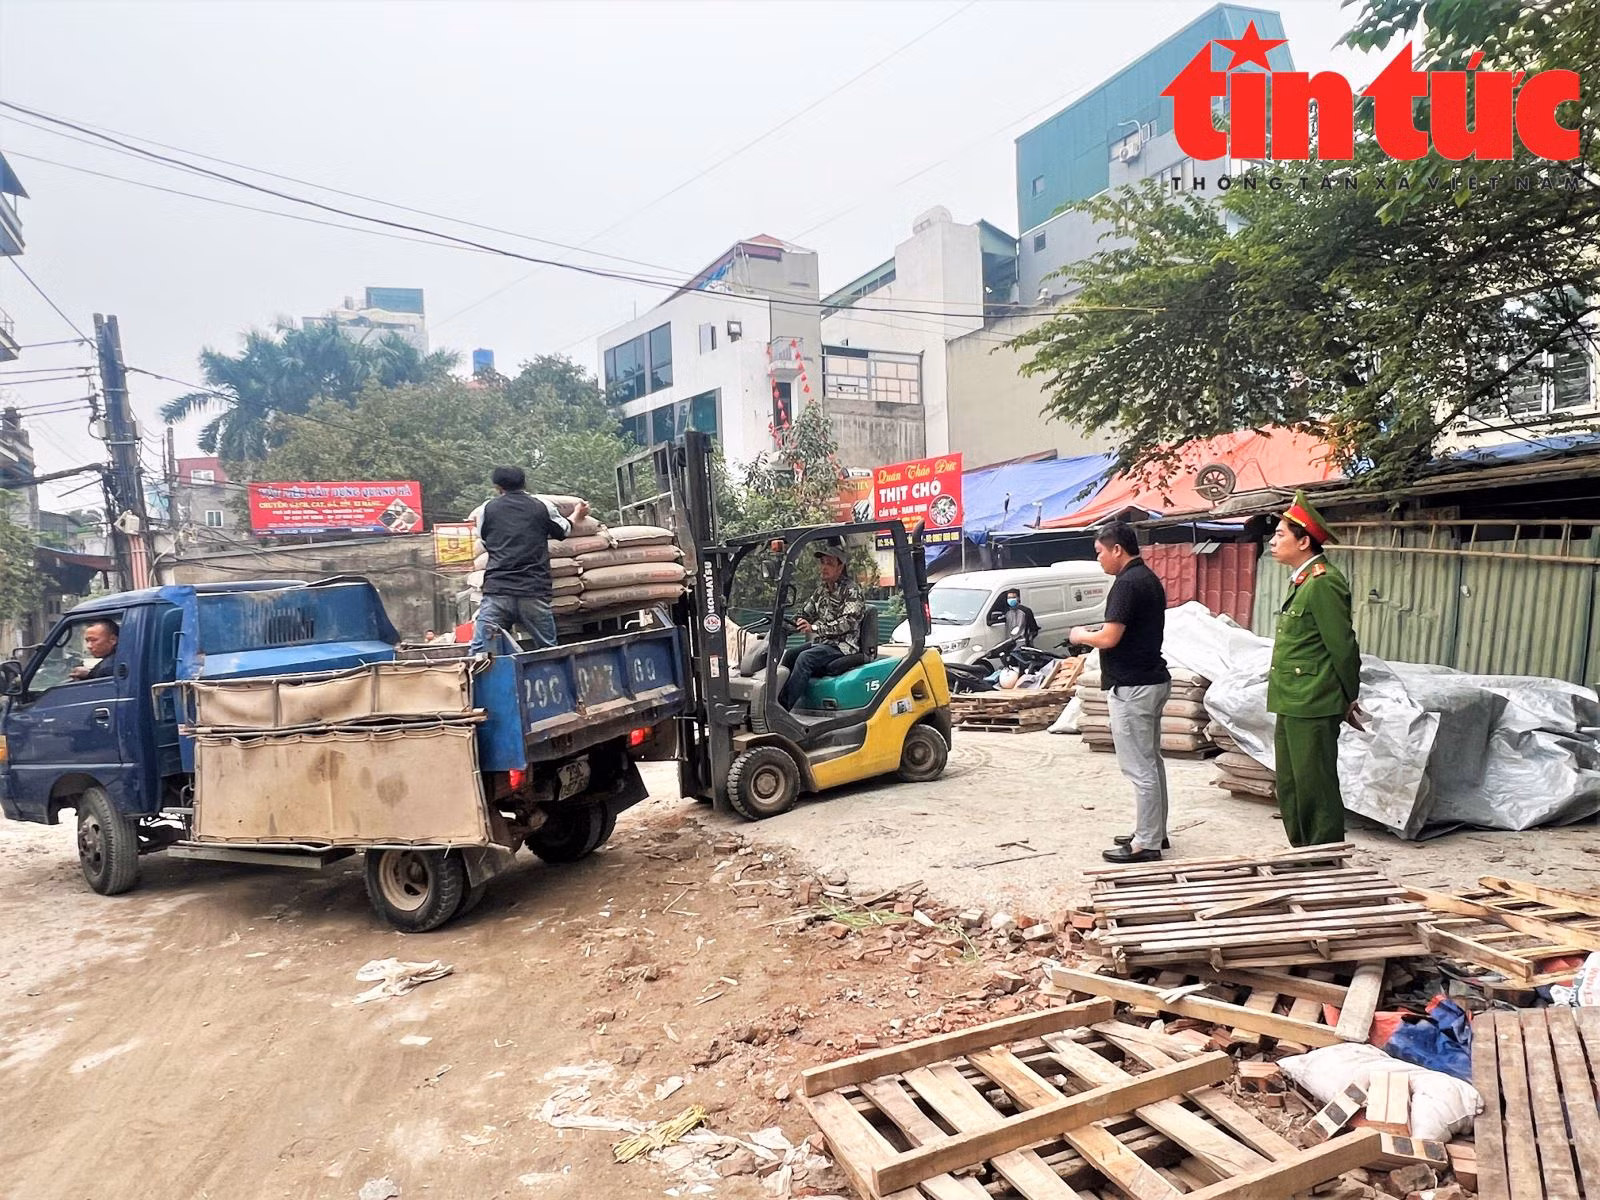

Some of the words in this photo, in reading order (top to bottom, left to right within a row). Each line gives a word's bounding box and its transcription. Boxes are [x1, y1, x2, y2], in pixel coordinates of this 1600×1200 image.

[361, 486, 396, 498] QUANG
[879, 485, 908, 504] THỊT
[911, 477, 941, 498] CHÓ
[703, 561, 715, 613] KOMATSU
[524, 675, 562, 708] 29C
[866, 680, 880, 692] 15
